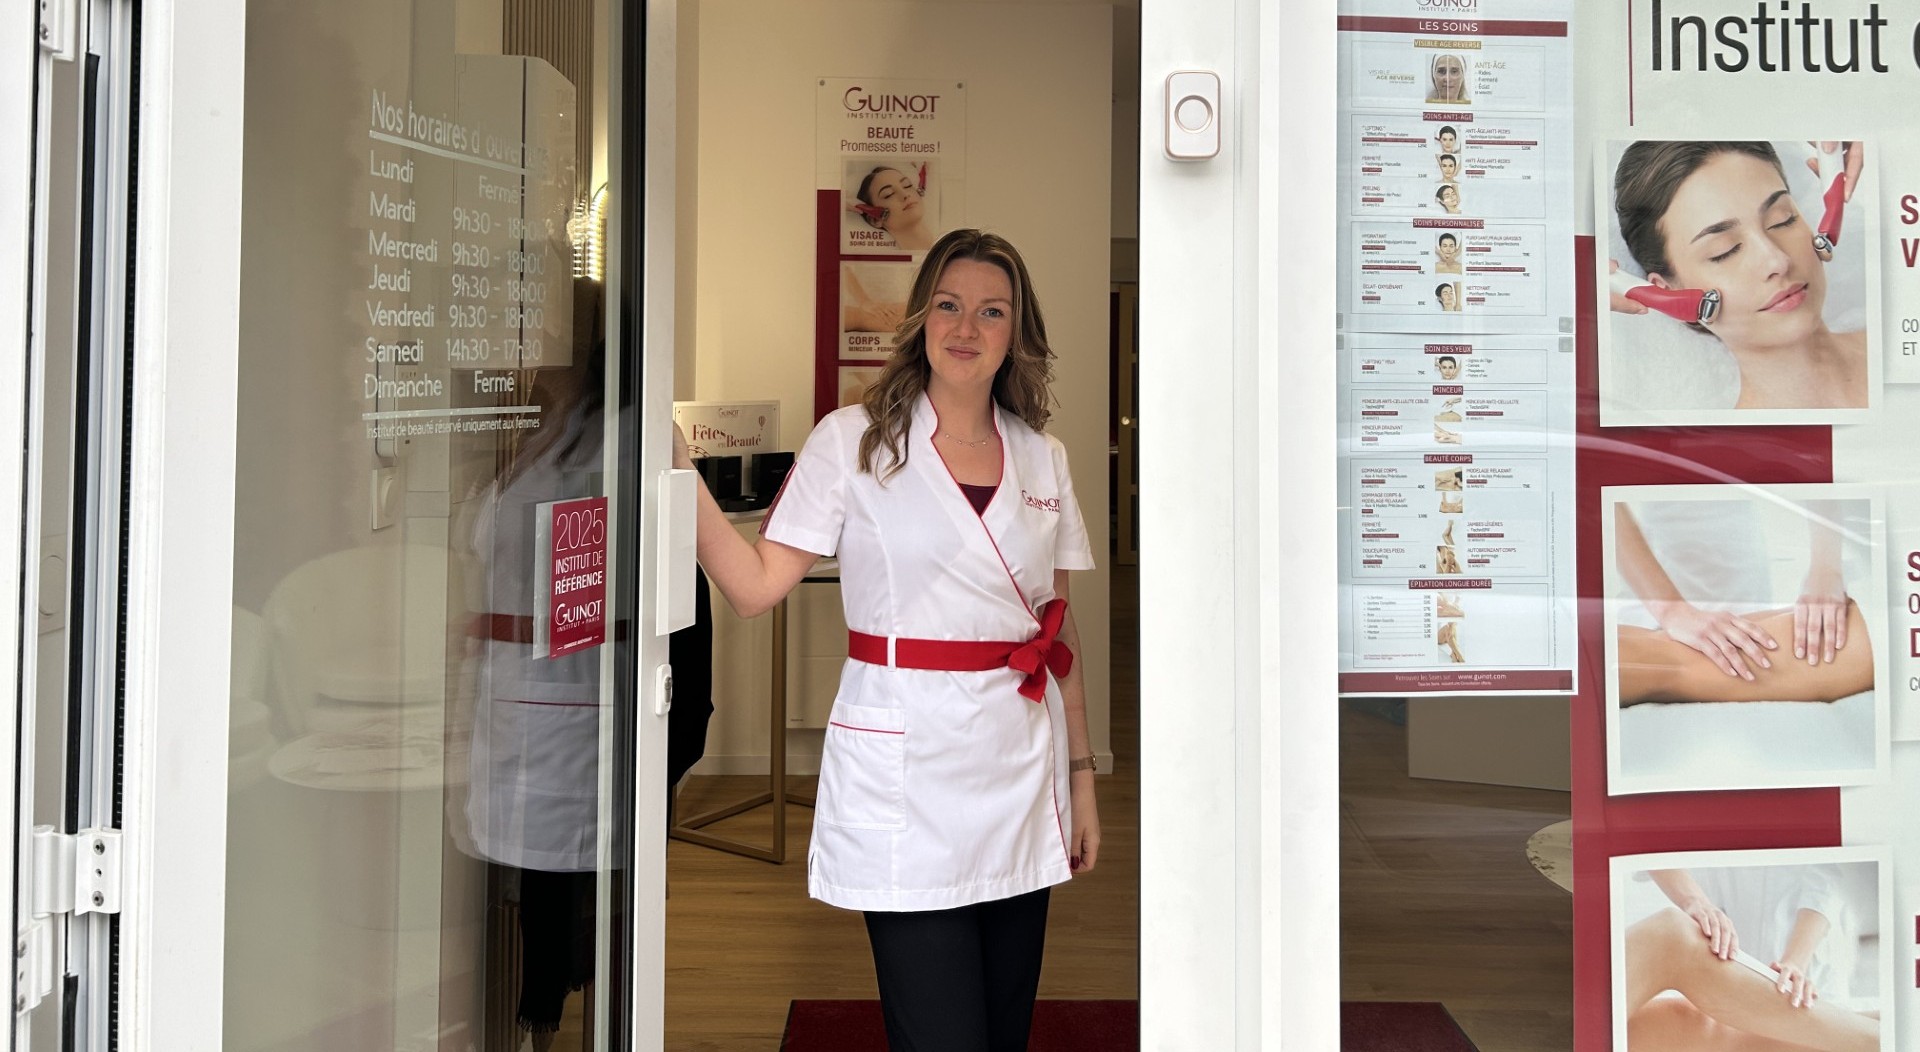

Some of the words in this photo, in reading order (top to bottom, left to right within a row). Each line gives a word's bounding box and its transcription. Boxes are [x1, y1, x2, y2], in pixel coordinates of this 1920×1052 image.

[1419, 21, 1439, 31] LES
[1443, 21, 1478, 32] SOINS
[1652, 0, 1889, 73] Institut
[842, 86, 941, 112] GUINOT
[371, 88, 404, 134] Nos
[408, 100, 468, 151] horaires
[867, 125, 914, 139] BEAUTÉ
[841, 139, 897, 153] Promesses
[901, 140, 935, 153] tenues
[370, 149, 414, 184] Lundi
[479, 175, 519, 205] Fermé
[370, 191, 416, 223] Mardi
[453, 207, 490, 234] 9h30
[1413, 219, 1433, 227] SOINS
[850, 231, 884, 240] VISAGE
[369, 229, 438, 263] Mercredi
[452, 242, 490, 269] 9h30
[368, 264, 411, 292] Jeudi
[452, 274, 490, 300] 9h30
[507, 279, 546, 304] 18h00
[366, 299, 435, 328] Vendredi
[449, 304, 487, 328] 9h30
[504, 306, 544, 330] 18h00
[365, 336, 424, 363] Samedi
[446, 338, 489, 362] 14h30
[503, 338, 542, 361] 17h30
[848, 336, 881, 345] CORPS
[1902, 342, 1918, 356] ET
[365, 373, 443, 399] Dimanche
[474, 370, 515, 394] Fermé
[1433, 386, 1463, 394] MINCEUR
[396, 421, 406, 436] de
[407, 419, 434, 436] beauté
[435, 417, 462, 434] réservé
[462, 418, 502, 434] uniquement
[503, 419, 514, 430] aux
[515, 415, 540, 430] femmes
[693, 424, 727, 441] Fêtes
[726, 434, 762, 448] Beauté
[1021, 489, 1060, 508] GUINOT
[556, 508, 604, 552] 2025
[556, 552, 591, 575] INSTITUT
[592, 550, 604, 567] DE
[555, 570, 603, 596] RÉFÉRENCE
[555, 600, 603, 626] GUINOT
